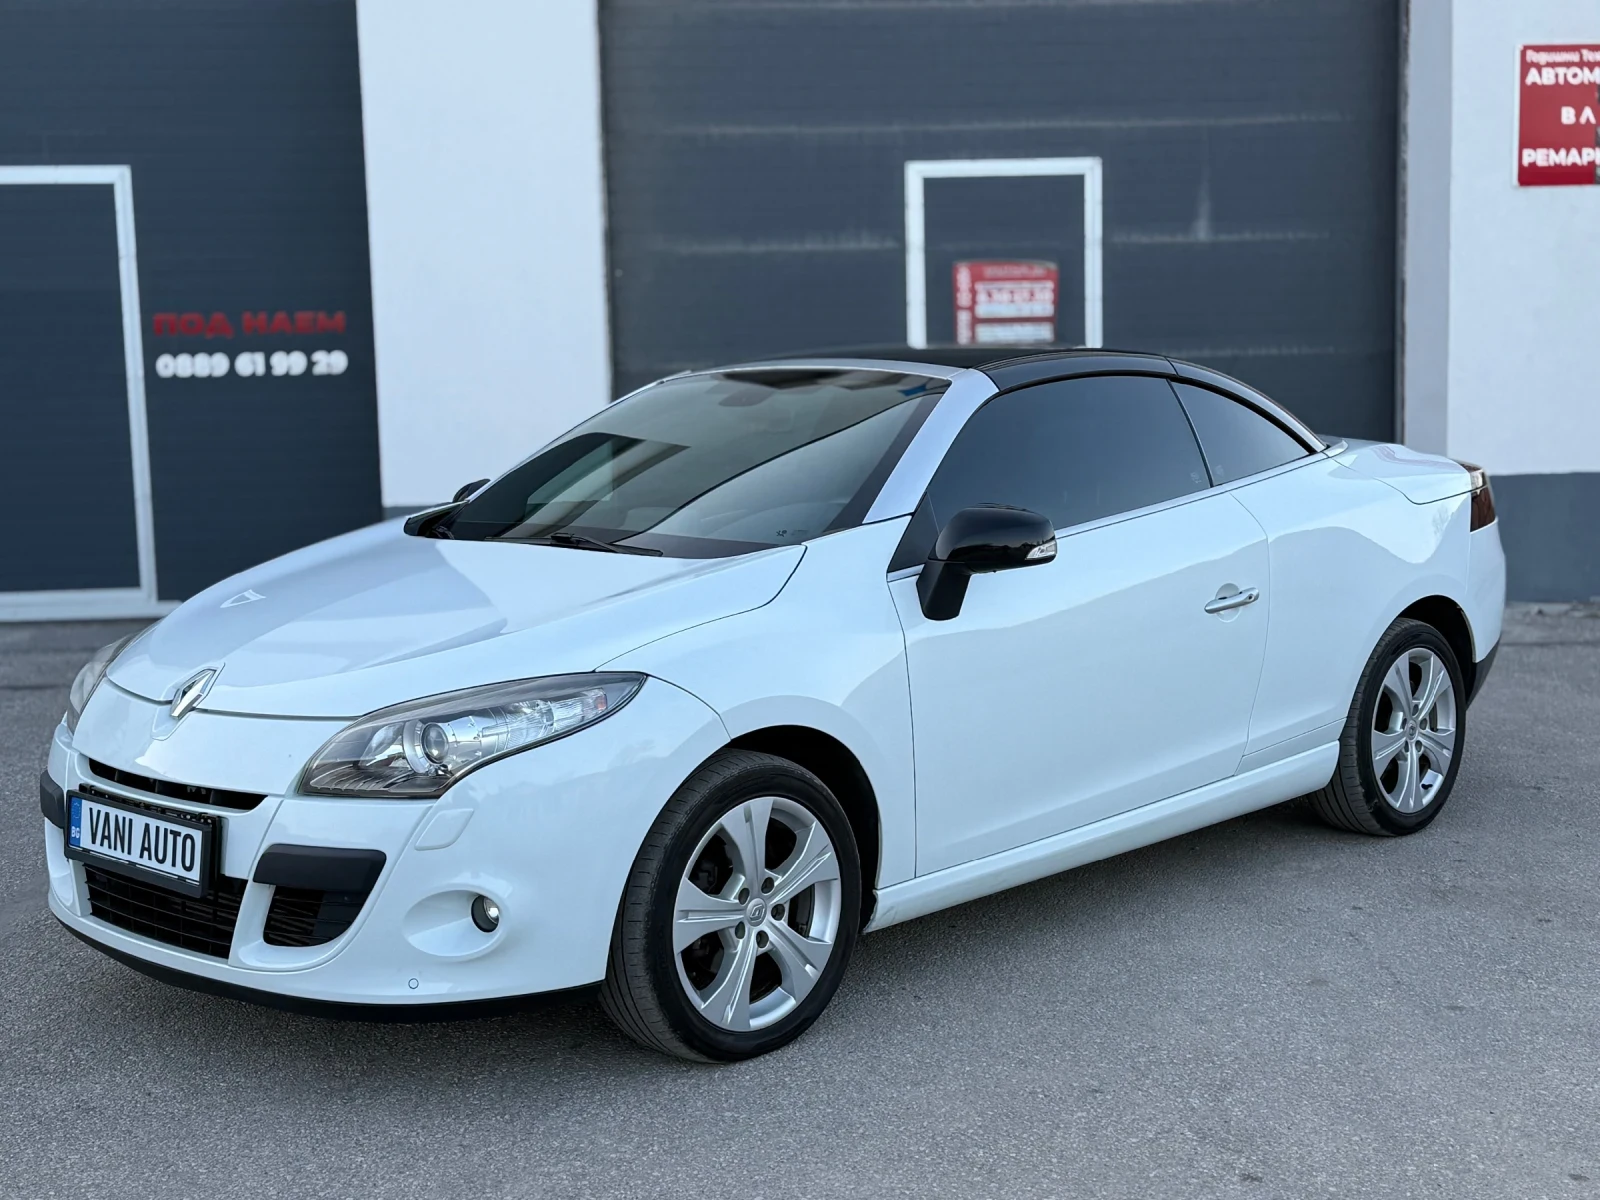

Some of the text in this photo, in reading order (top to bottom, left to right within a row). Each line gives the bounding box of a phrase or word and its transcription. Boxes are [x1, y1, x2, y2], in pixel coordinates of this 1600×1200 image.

[1525, 67, 1600, 85] АВТОМ
[153, 311, 346, 339] ПОД НАЕМ
[234, 351, 266, 377] 61
[269, 350, 308, 376] 99
[310, 350, 348, 376] 29
[71, 826, 81, 839] BG
[89, 807, 195, 872] VANI AUTO
